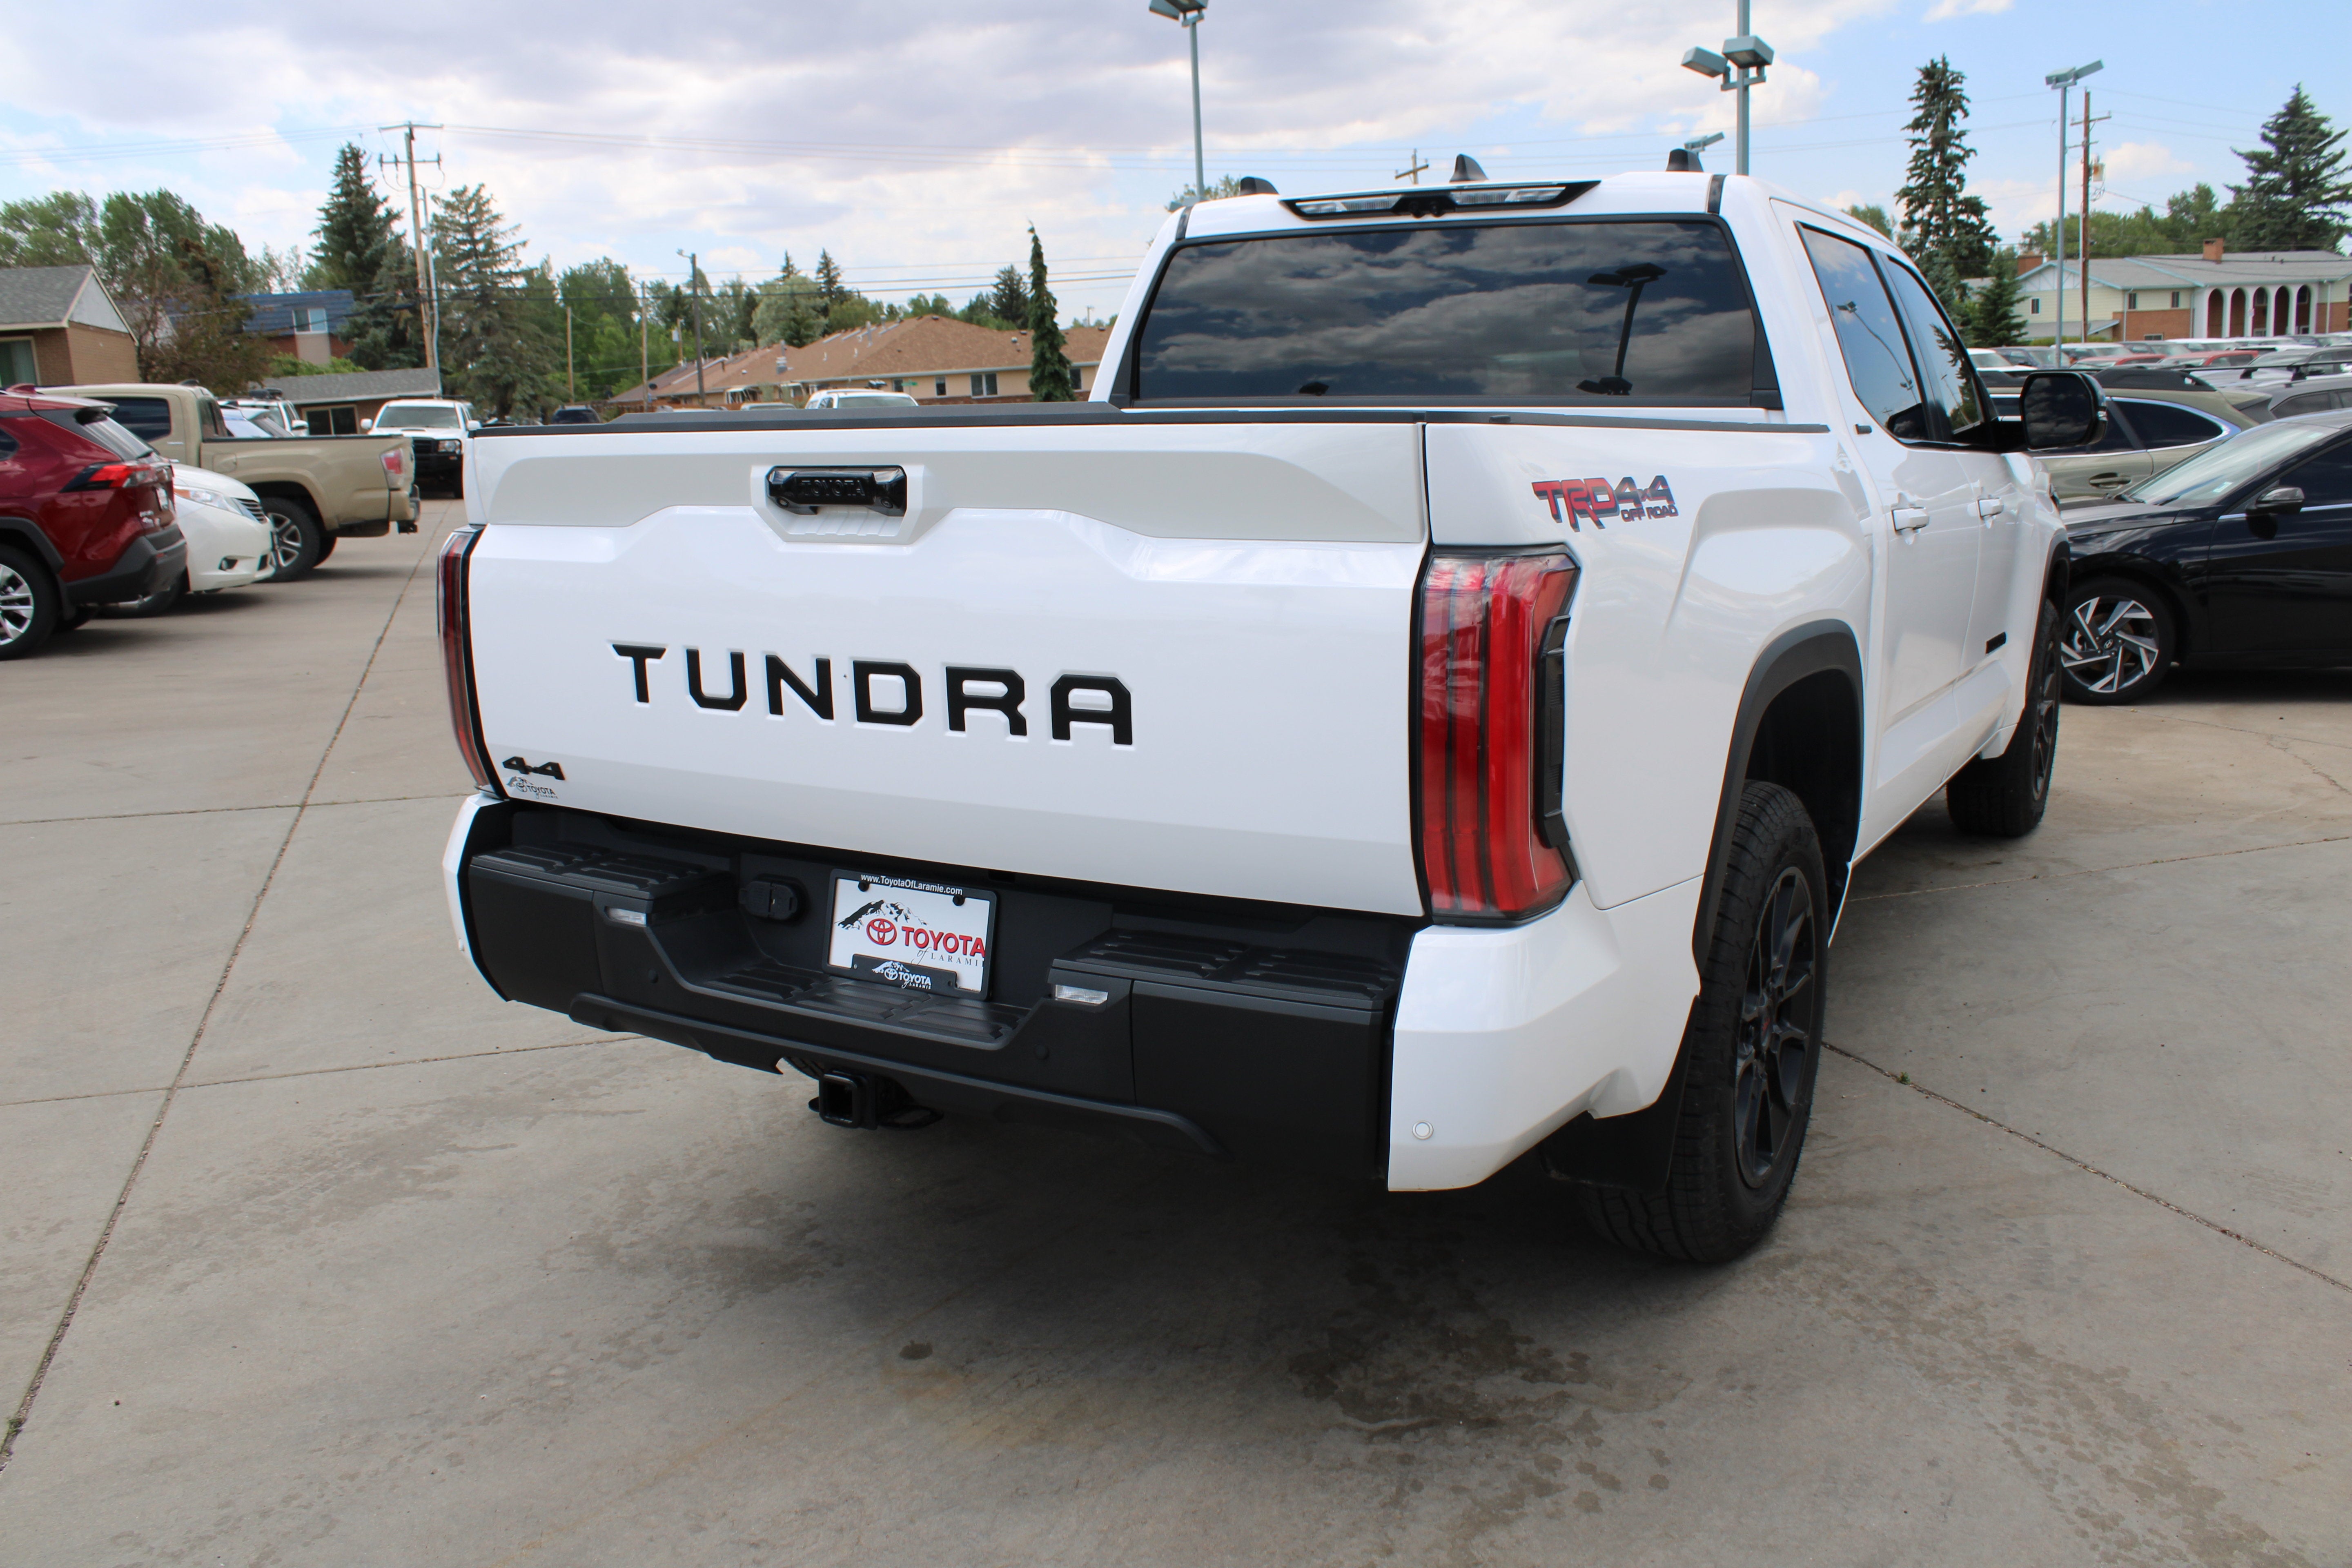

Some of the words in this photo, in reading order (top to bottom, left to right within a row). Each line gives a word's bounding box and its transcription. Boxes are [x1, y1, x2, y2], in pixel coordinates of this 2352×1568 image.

[801, 480, 865, 496] TOYOTA
[1531, 477, 1619, 532] TRD
[1621, 507, 1646, 522] OFF
[1646, 504, 1679, 519] ROAD
[612, 644, 1133, 745] TUNDRA
[526, 785, 556, 795] TOYOTA
[861, 874, 963, 895] www.ToyotaOfLaramie.com
[902, 926, 985, 958] TOYOTA
[911, 947, 932, 965] of
[931, 952, 984, 967] LARAMI
[899, 971, 932, 986] TOYOTA
